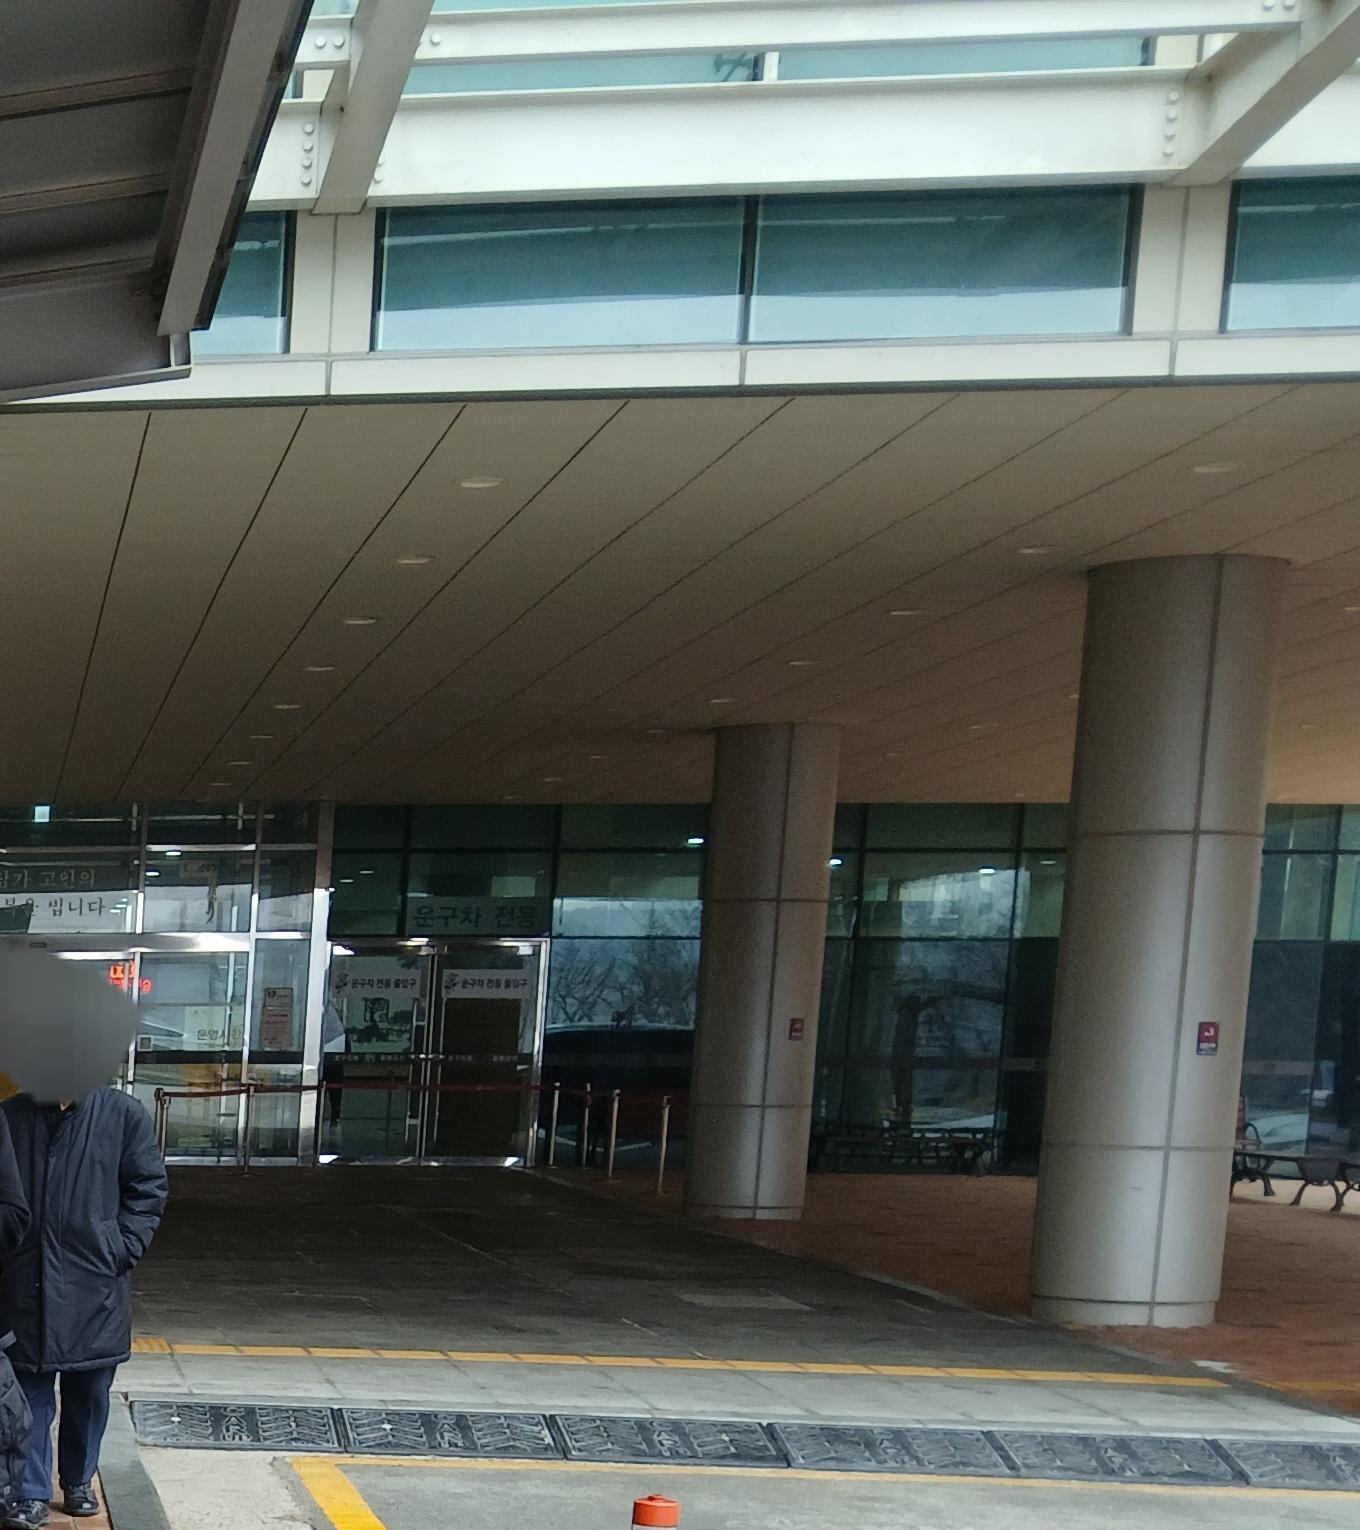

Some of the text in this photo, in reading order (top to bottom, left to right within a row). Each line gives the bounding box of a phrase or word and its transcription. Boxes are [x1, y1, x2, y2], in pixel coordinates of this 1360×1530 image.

[38, 868, 95, 888] 고인의
[48, 897, 106, 917] 빕니다
[414, 904, 538, 928] 운구차 전용
